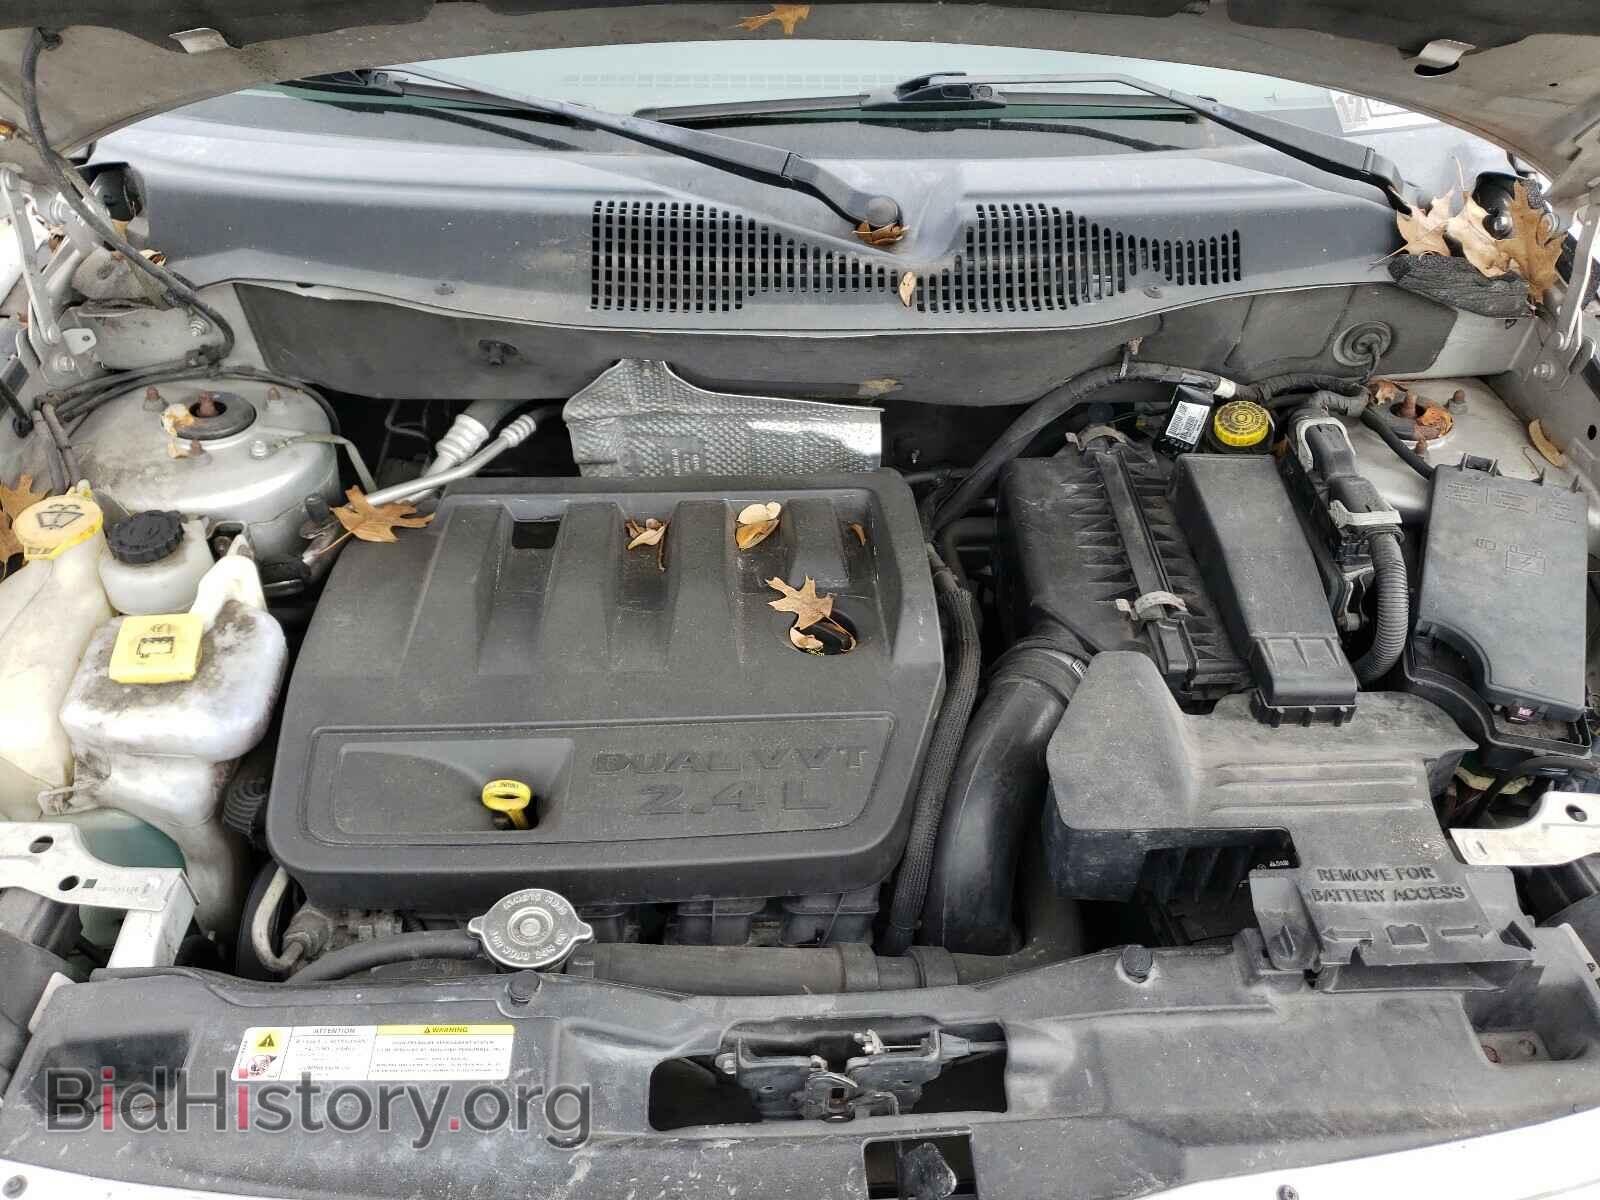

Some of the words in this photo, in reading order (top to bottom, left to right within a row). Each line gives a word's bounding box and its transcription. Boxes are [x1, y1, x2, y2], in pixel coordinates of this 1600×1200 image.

[594, 751, 742, 775] DUAL
[756, 744, 869, 770] VVT
[638, 781, 832, 816] 2.4L
[1316, 867, 1392, 882] REMOVE
[1395, 865, 1435, 881] FOR
[1312, 888, 1386, 902] BATTERY
[1393, 885, 1466, 901] ACCESS
